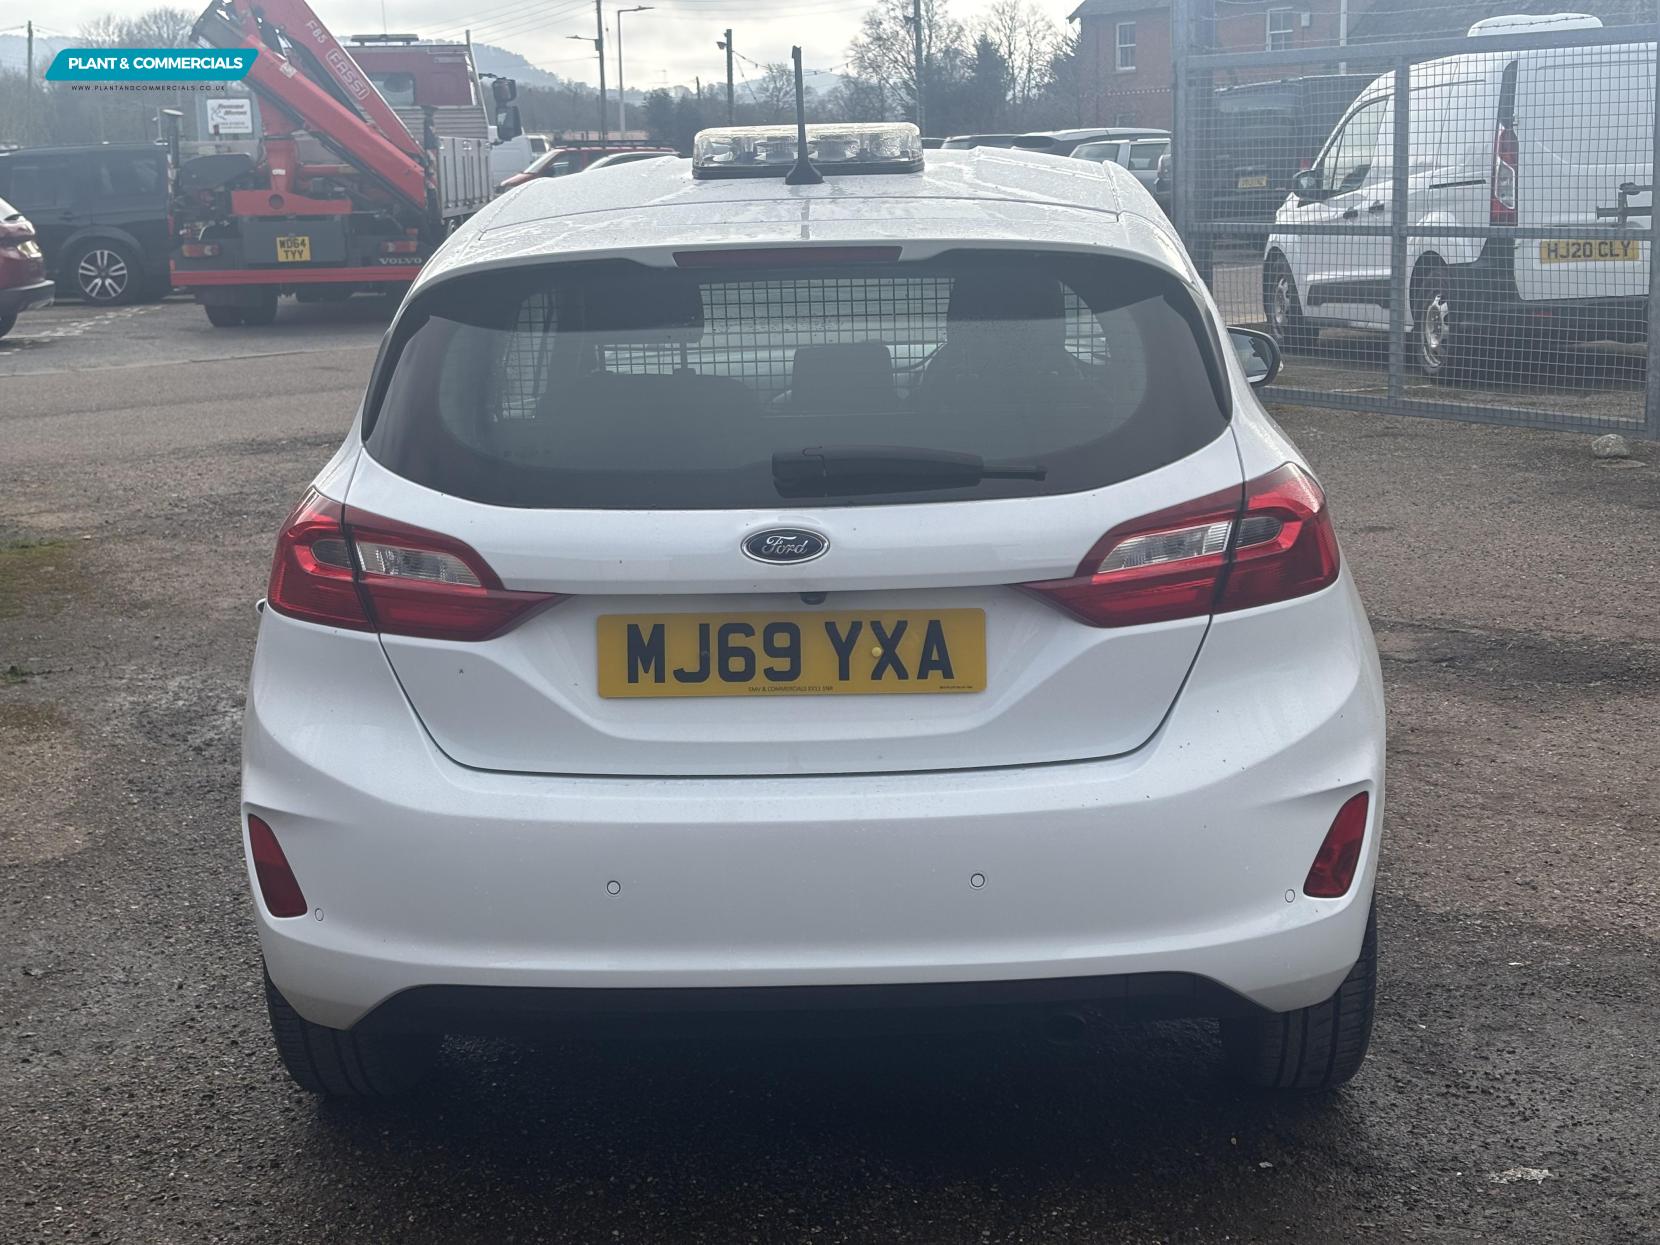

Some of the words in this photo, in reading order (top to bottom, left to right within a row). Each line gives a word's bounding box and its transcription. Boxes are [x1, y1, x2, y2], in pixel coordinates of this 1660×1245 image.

[328, 52, 367, 98] FASSI
[279, 238, 307, 249] WD64
[1547, 242, 1593, 258] HJ20
[1598, 240, 1632, 257] CLY
[284, 249, 304, 259] TYY
[761, 535, 809, 554] Ford
[626, 622, 800, 684] MJ69
[824, 619, 955, 681] YXA
